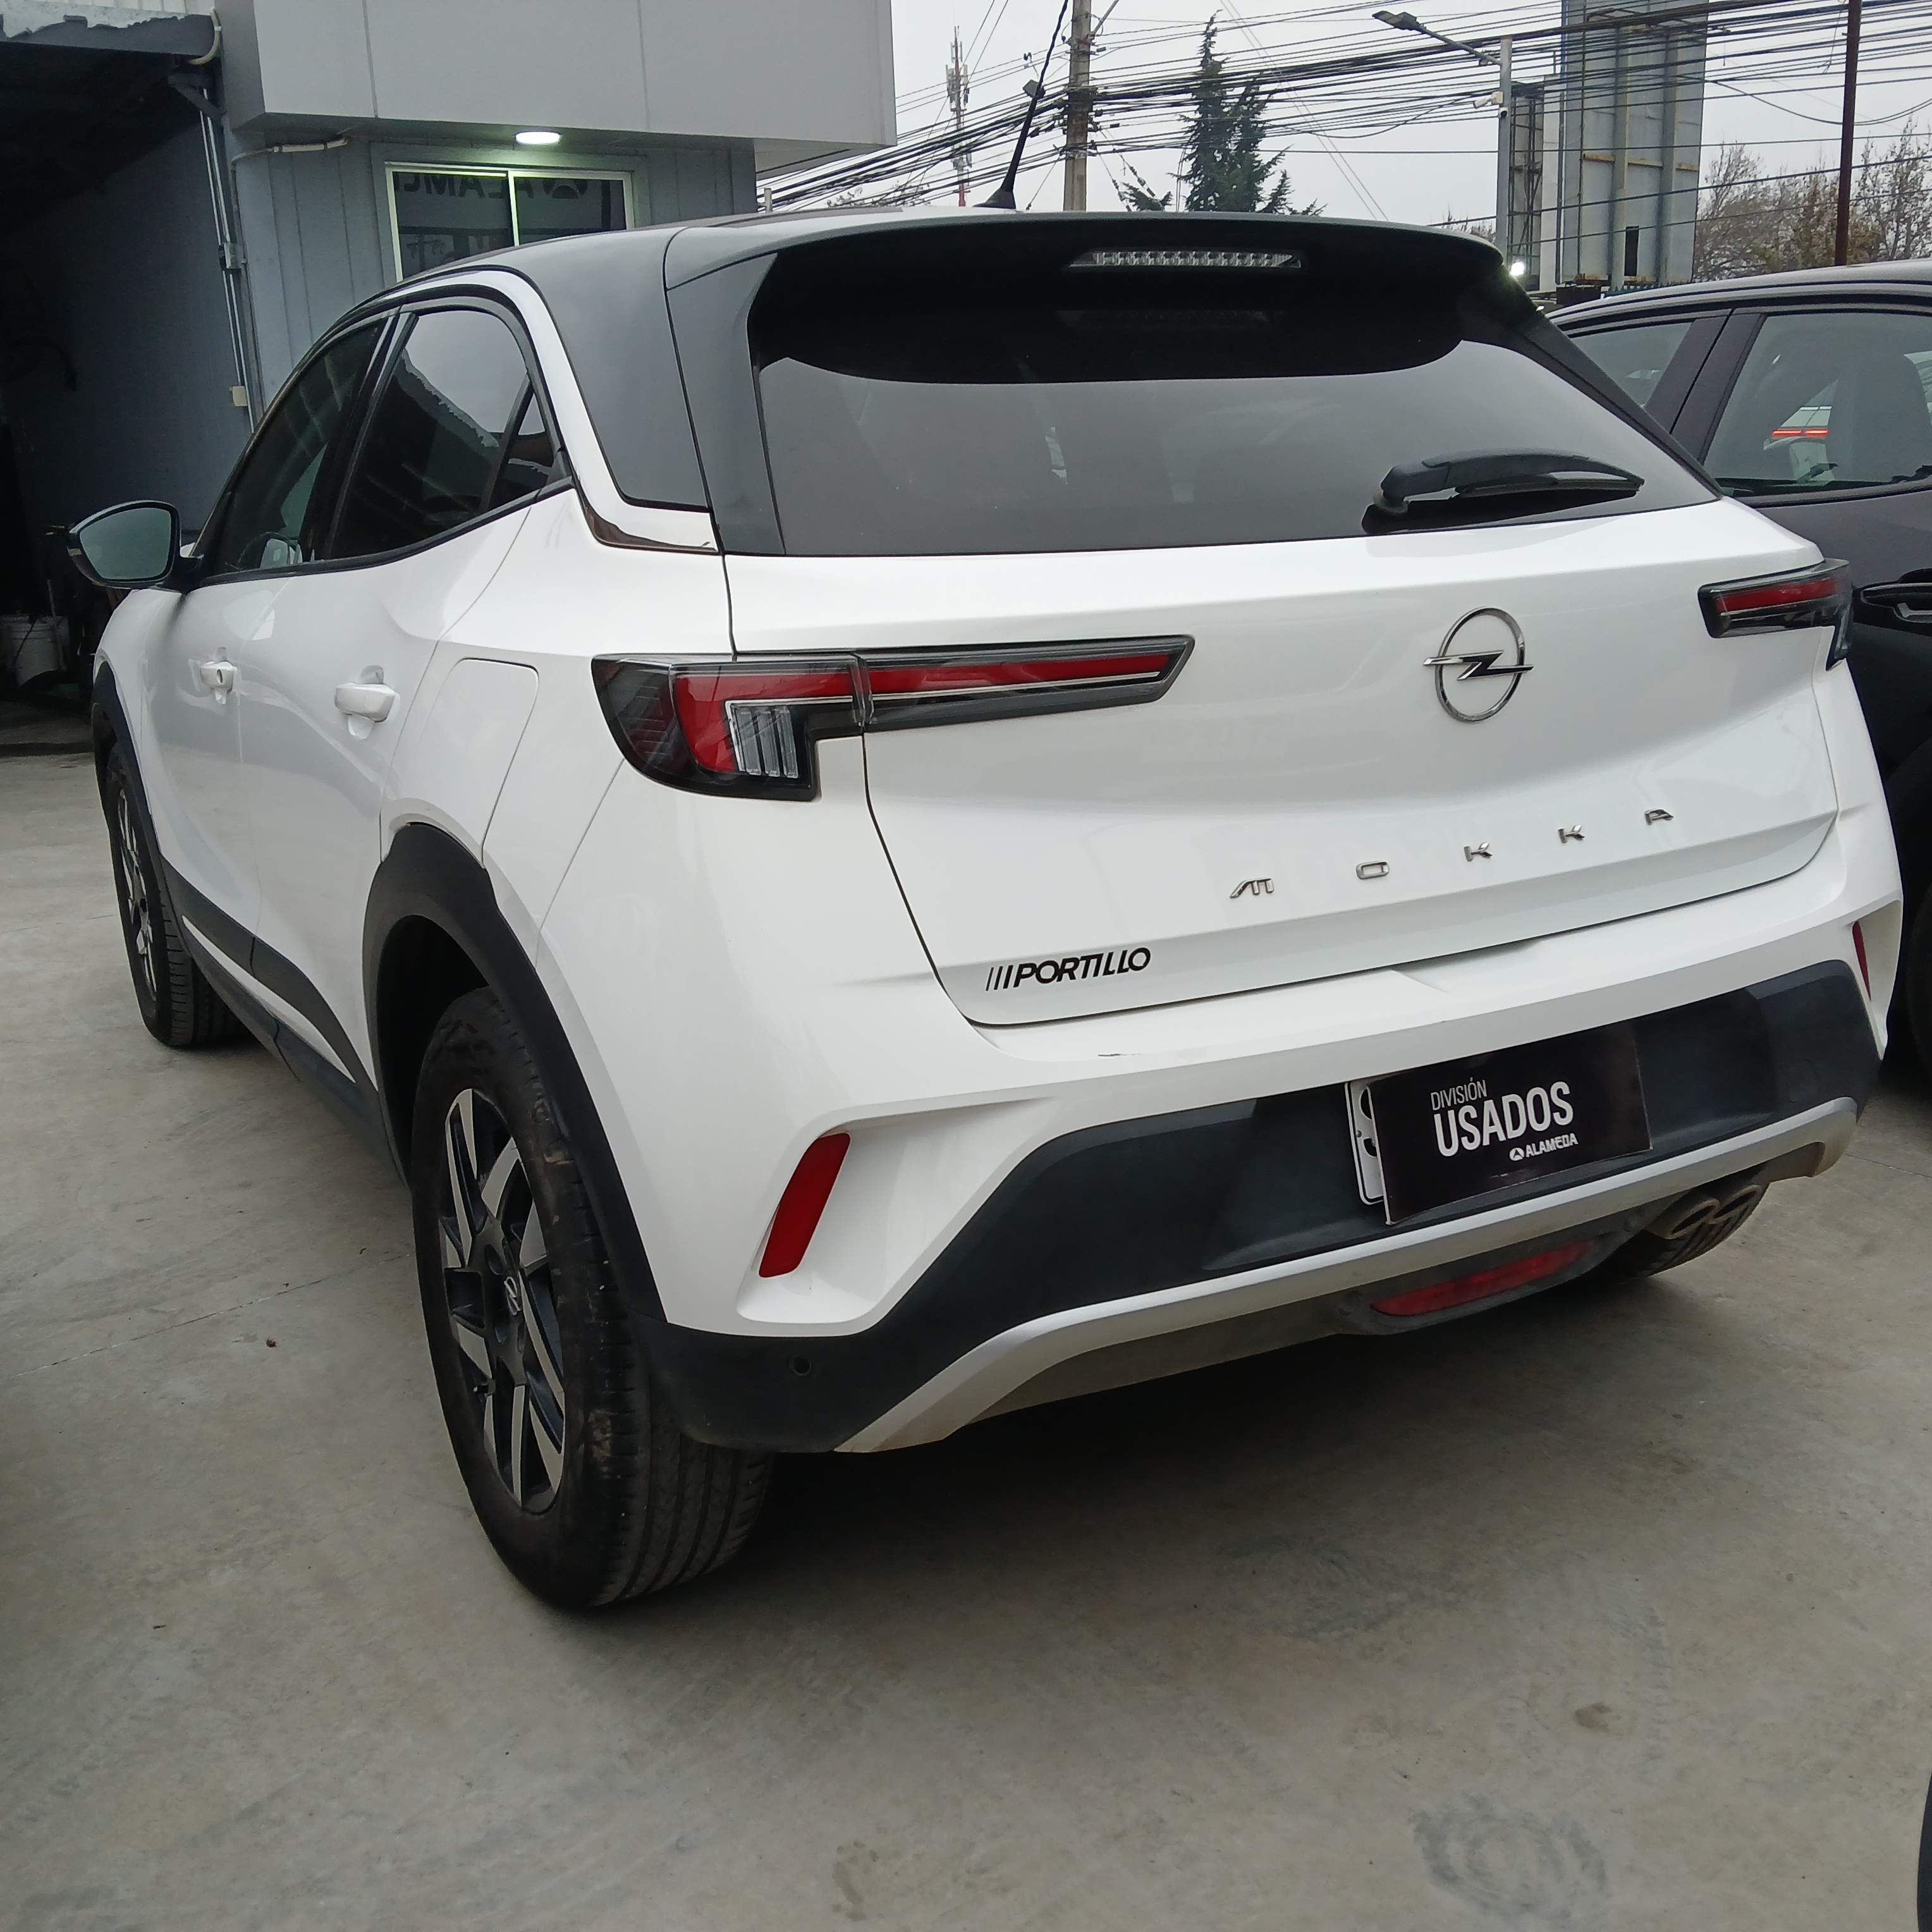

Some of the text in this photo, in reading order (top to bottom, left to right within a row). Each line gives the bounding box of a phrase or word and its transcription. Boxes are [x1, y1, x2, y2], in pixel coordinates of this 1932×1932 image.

[1230, 808, 1674, 898] MOKKA
[1431, 1077, 1488, 1111] DIVISIÓN
[1433, 1081, 1574, 1157] USADOS
[1525, 1133, 1579, 1158] ALAMEDA
